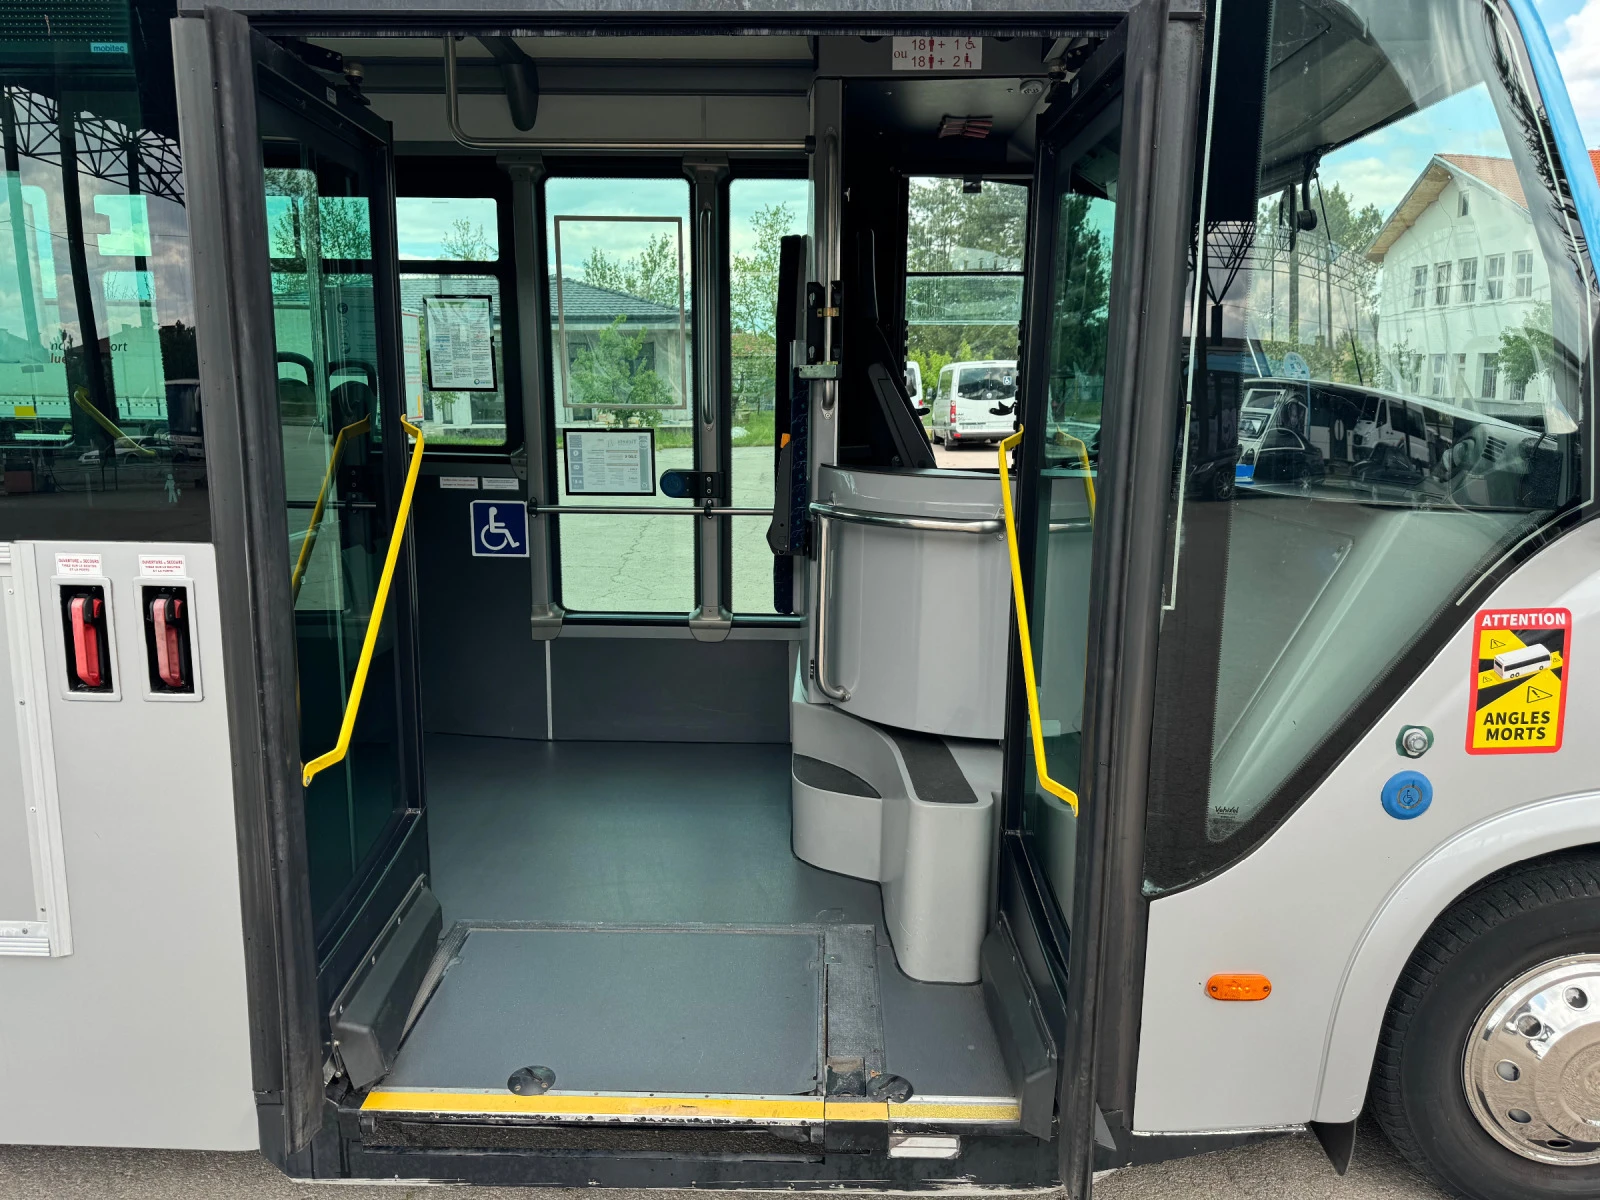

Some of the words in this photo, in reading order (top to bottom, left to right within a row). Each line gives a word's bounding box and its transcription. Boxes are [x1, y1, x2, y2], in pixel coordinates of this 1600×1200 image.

[912, 39, 926, 50] 18
[954, 39, 959, 50] 1
[894, 50, 907, 58] ou
[912, 56, 926, 67] 18
[953, 56, 960, 67] 2
[1482, 612, 1566, 626] ATTENTION
[1483, 711, 1551, 726] ANGLES
[1486, 727, 1546, 741] MORTS
